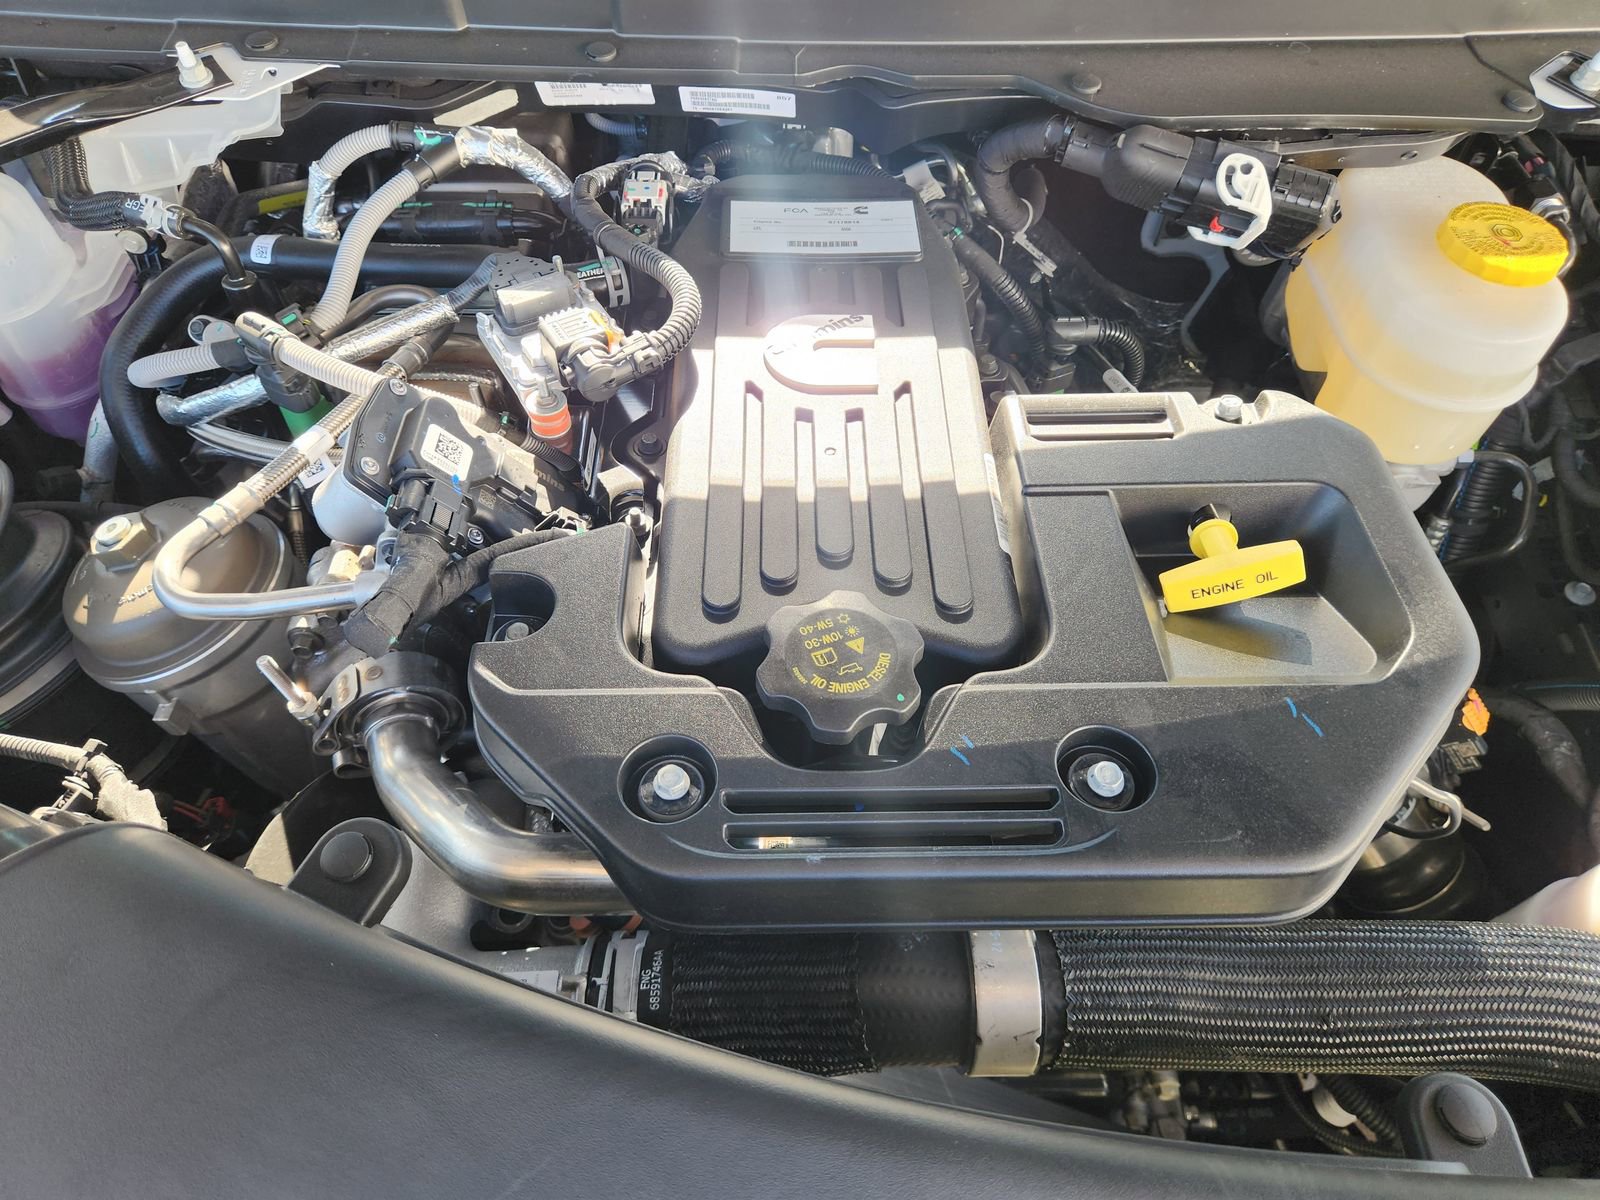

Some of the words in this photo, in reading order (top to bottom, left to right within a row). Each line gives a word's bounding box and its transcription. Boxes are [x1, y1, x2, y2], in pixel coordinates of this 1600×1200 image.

[1191, 579, 1245, 599] ENGINE
[1255, 570, 1279, 584] OIL
[799, 618, 834, 636] 5W-40
[804, 631, 843, 649] 10W-30
[866, 652, 891, 682] DIESEL
[810, 673, 827, 689] OIL
[826, 677, 871, 693] ENGINE
[640, 969, 652, 990] ENG
[649, 949, 665, 1011] 68591746AA
